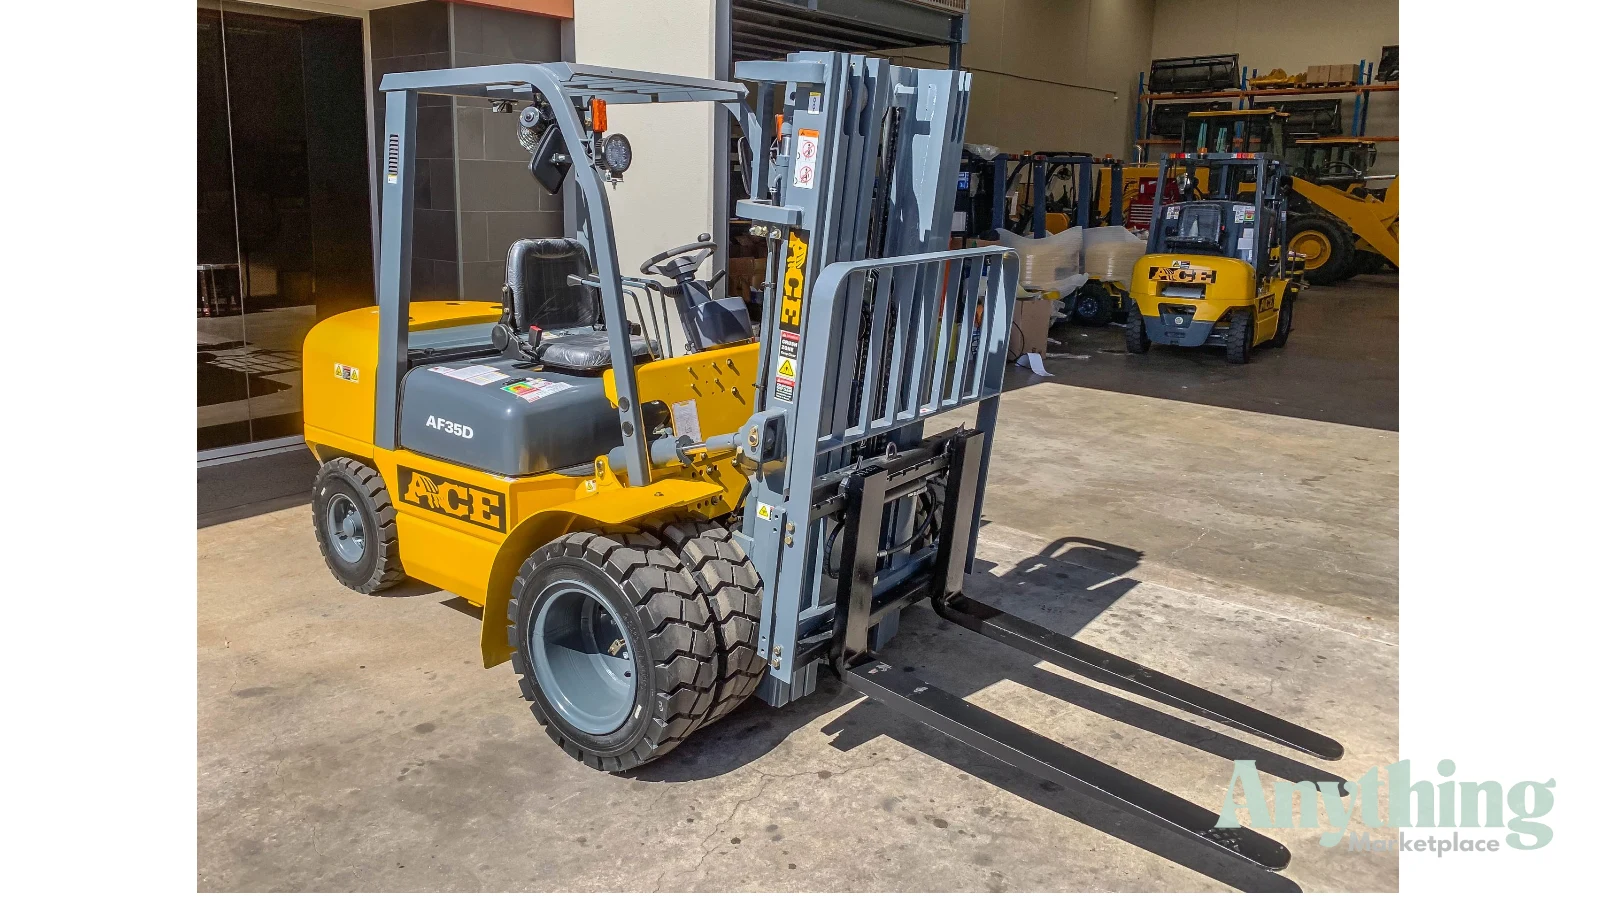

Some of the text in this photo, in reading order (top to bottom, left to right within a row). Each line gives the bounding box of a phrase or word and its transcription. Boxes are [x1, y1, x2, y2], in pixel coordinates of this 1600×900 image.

[781, 231, 808, 326] ACE
[1152, 267, 1213, 283] ACE
[426, 415, 474, 439] AF35D
[404, 471, 500, 529] ACE
